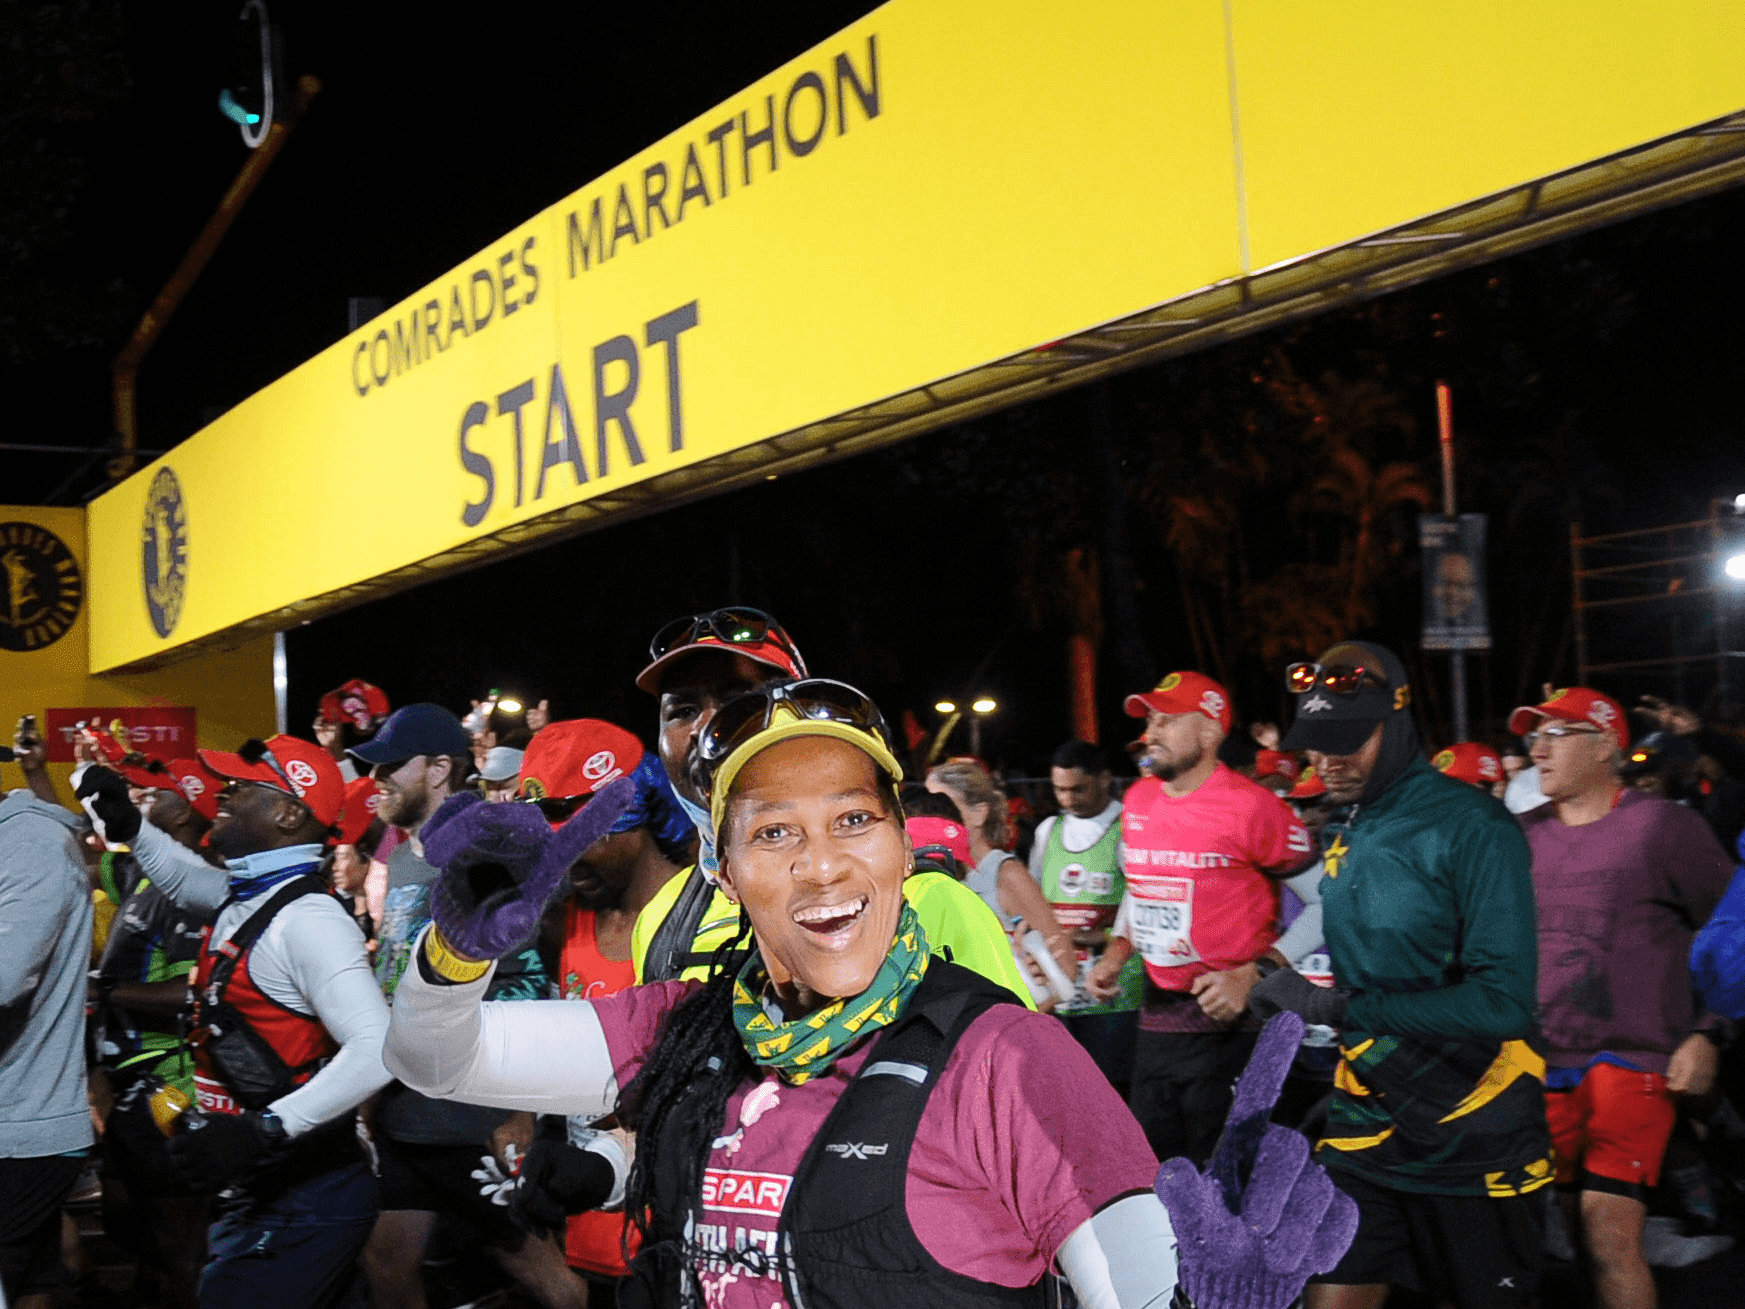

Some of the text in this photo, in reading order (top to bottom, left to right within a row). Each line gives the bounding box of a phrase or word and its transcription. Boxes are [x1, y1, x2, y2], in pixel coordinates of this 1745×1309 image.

[352, 33, 882, 397] COMRADES MARATHON
[457, 298, 701, 527] START
[701, 1175, 784, 1207] SPAR
